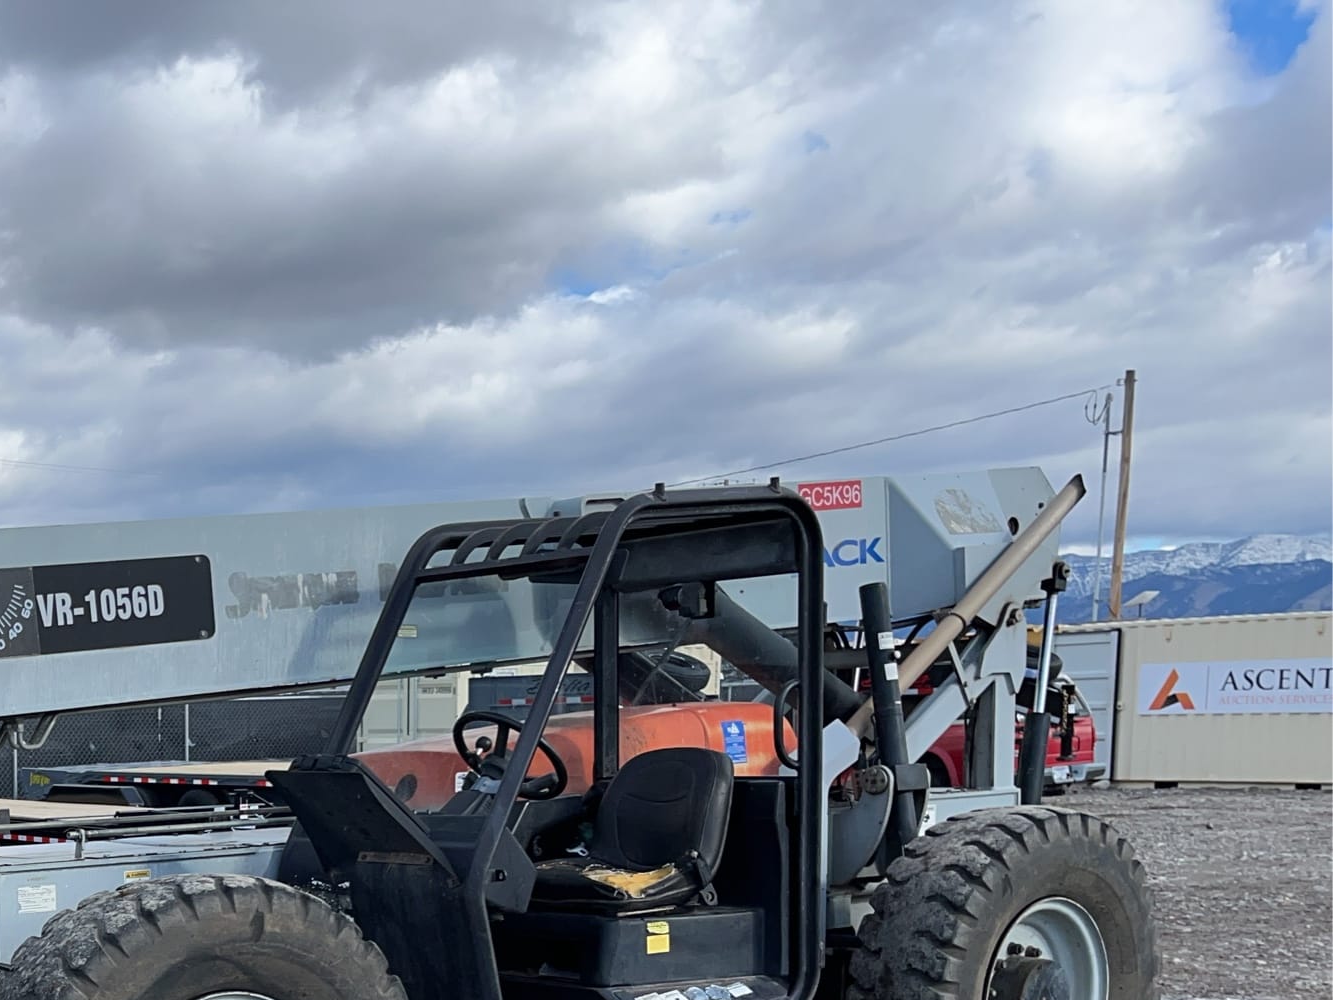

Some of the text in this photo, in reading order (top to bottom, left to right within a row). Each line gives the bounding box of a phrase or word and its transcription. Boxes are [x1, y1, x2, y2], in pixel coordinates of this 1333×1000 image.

[21, 599, 34, 619] 60
[36, 584, 165, 628] VR-1056D
[8, 622, 23, 640] 40
[1219, 668, 1333, 692] ASCENT
[1219, 694, 1271, 705] AUCTION
